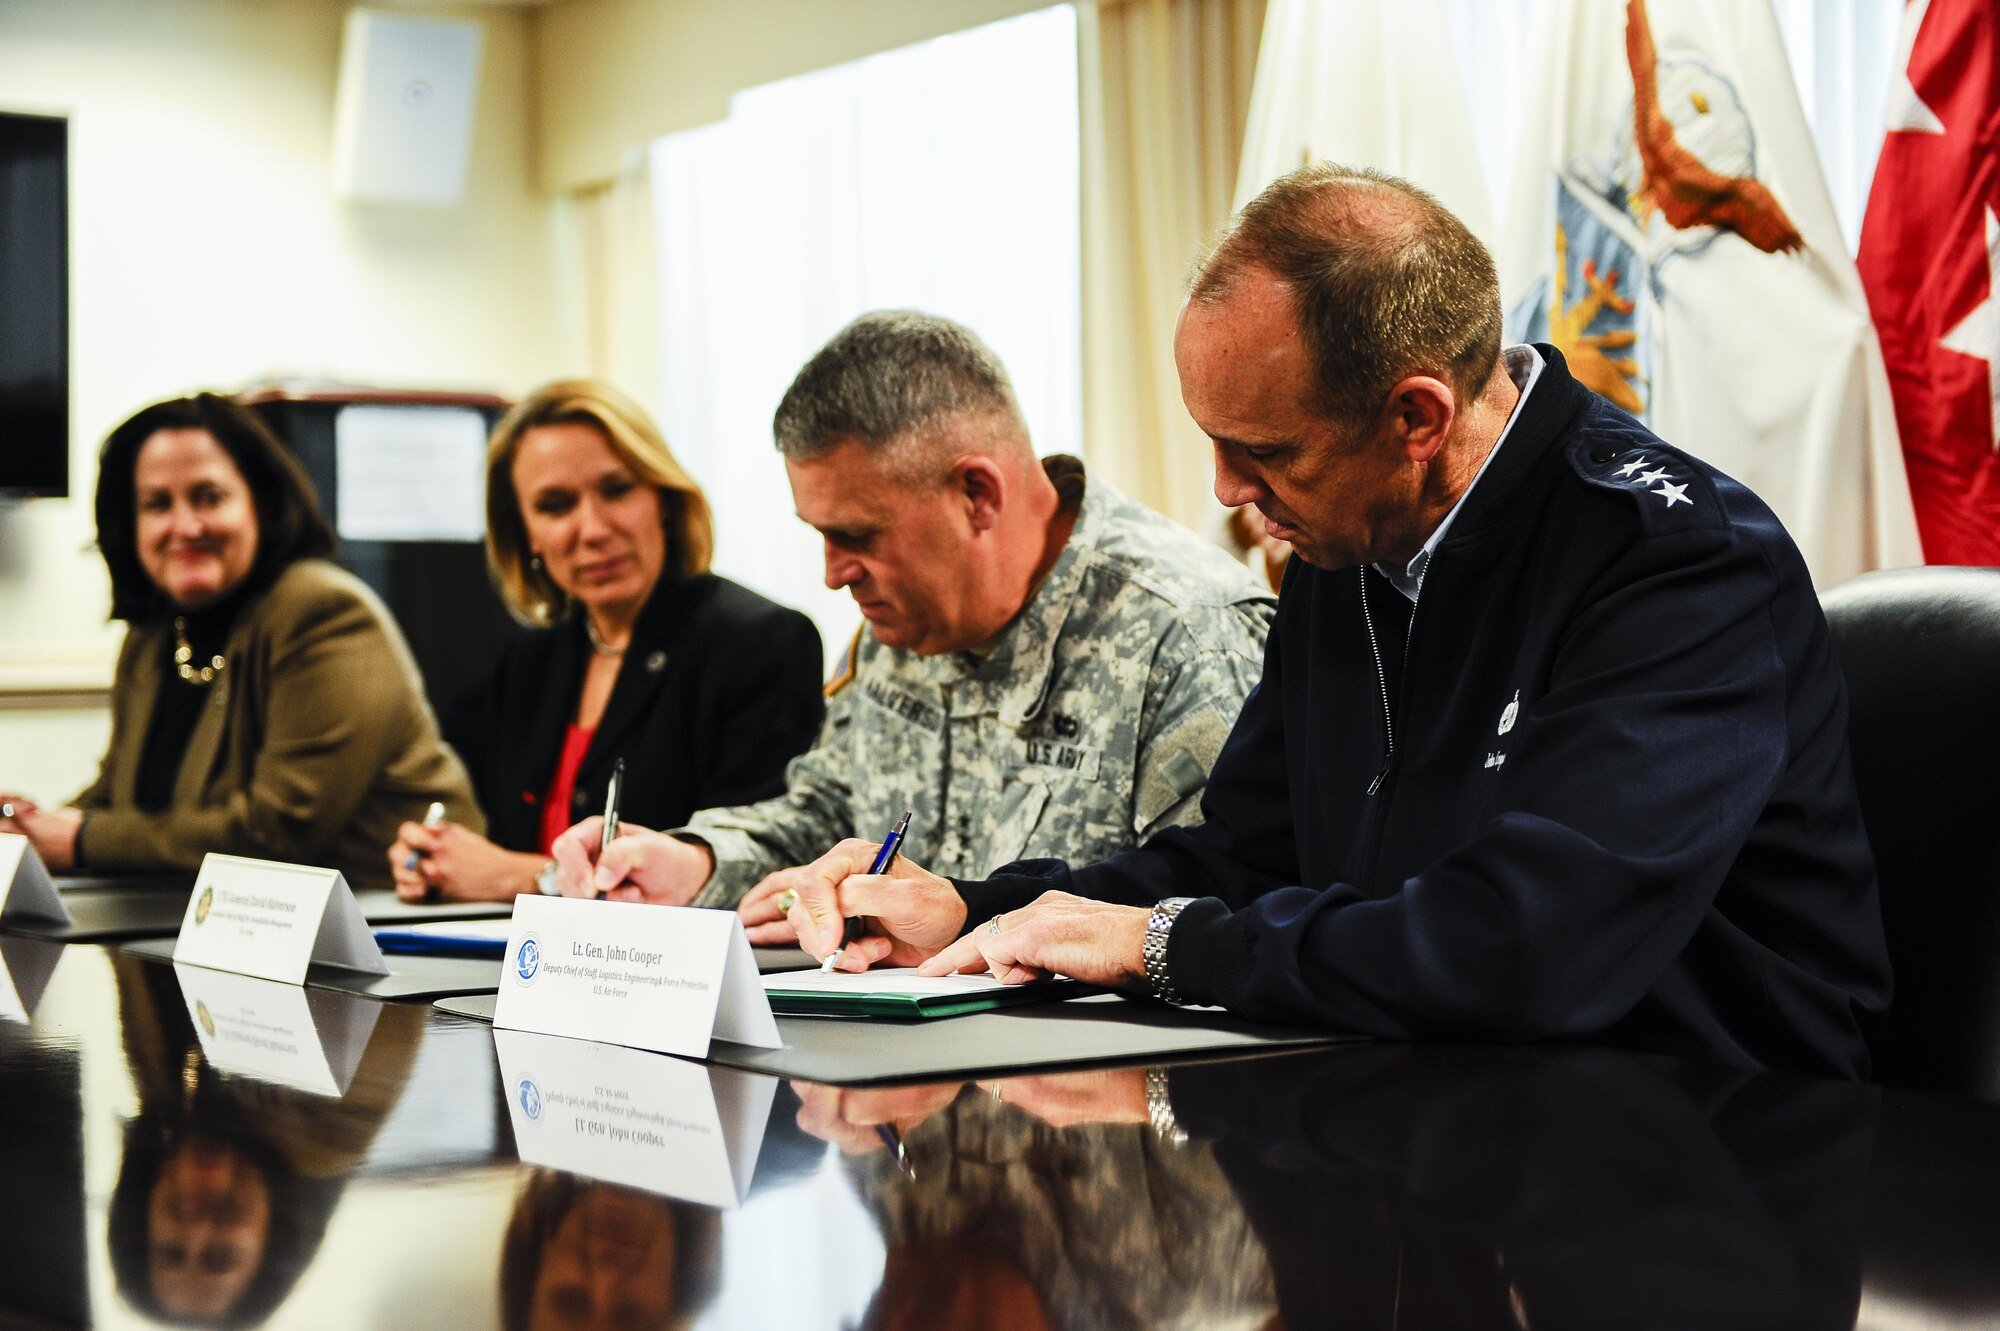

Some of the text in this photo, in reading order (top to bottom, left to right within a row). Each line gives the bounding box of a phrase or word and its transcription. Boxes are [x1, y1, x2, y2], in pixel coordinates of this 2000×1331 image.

[1056, 745, 1087, 771] ARMY
[572, 941, 663, 968] Lt. Gen. John Cooper
[543, 962, 563, 976] Deputy
[563, 965, 578, 978] Chief
[577, 966, 585, 978] of
[663, 976, 680, 988] Force
[603, 986, 612, 997] Air
[612, 987, 629, 999] Force
